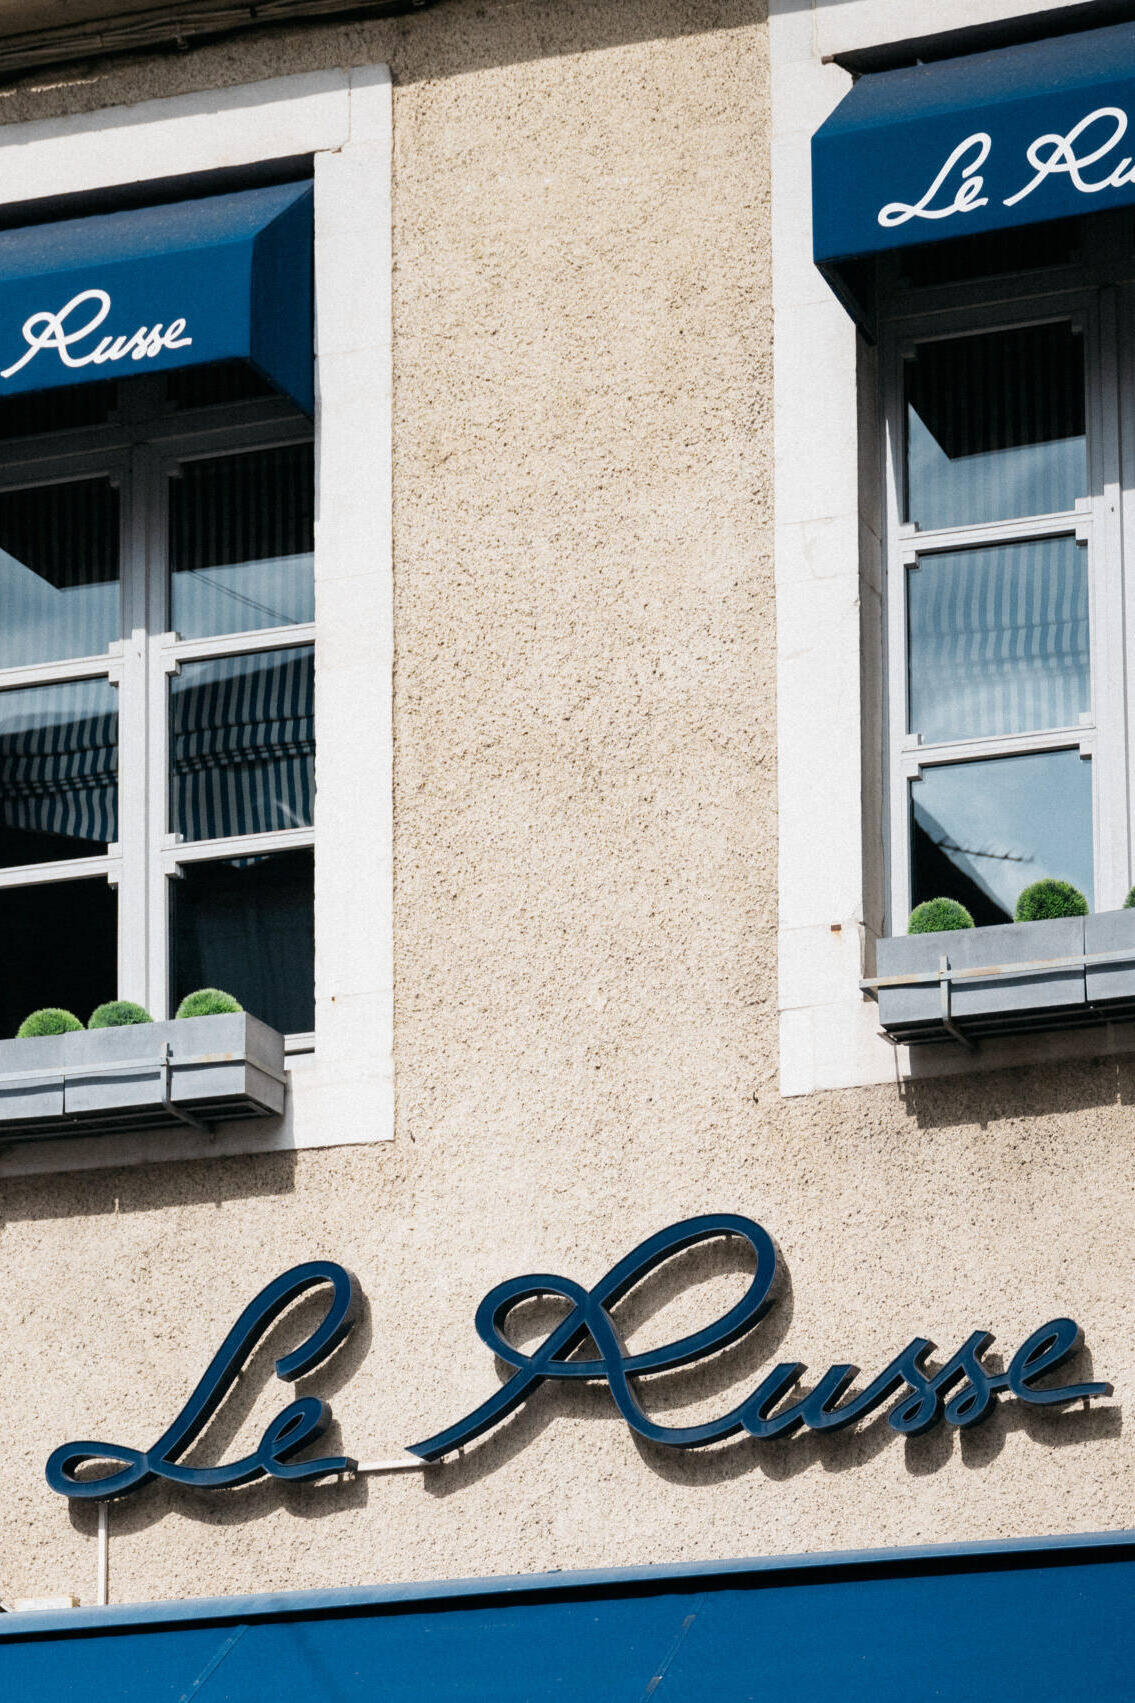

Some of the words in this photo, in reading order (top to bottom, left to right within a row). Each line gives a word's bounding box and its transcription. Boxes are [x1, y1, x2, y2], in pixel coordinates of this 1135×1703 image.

[877, 132, 992, 228] Le
[0, 288, 193, 379] Russe
[45, 1260, 358, 1500] Le
[404, 1213, 1113, 1463] Russe
